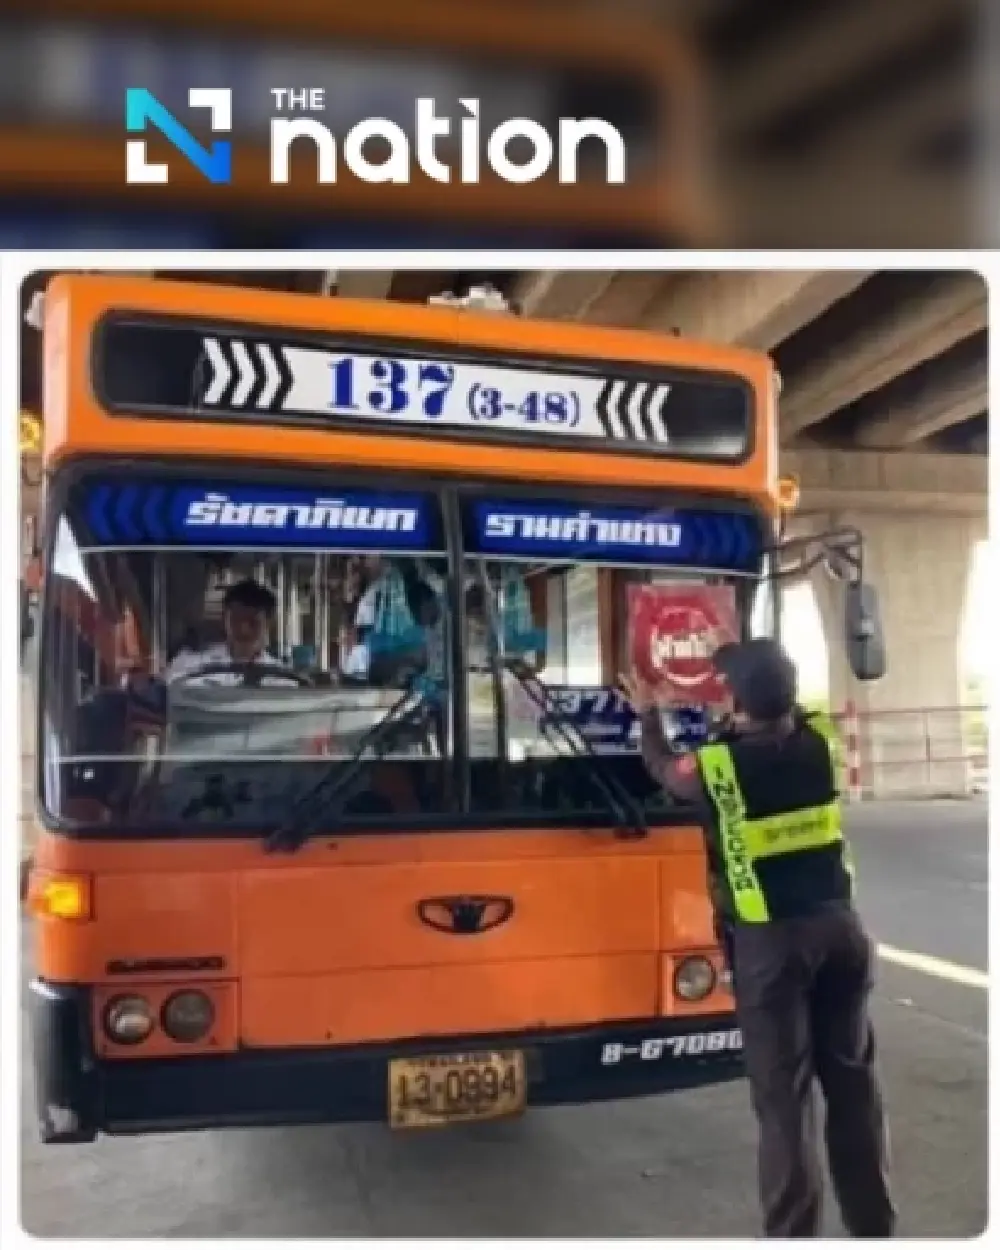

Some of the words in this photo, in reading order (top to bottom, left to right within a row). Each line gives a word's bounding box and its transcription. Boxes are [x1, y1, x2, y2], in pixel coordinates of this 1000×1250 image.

[328, 357, 454, 419] 137
[466, 382, 580, 428] (3-48)
[486, 512, 681, 548] รามคำแหง
